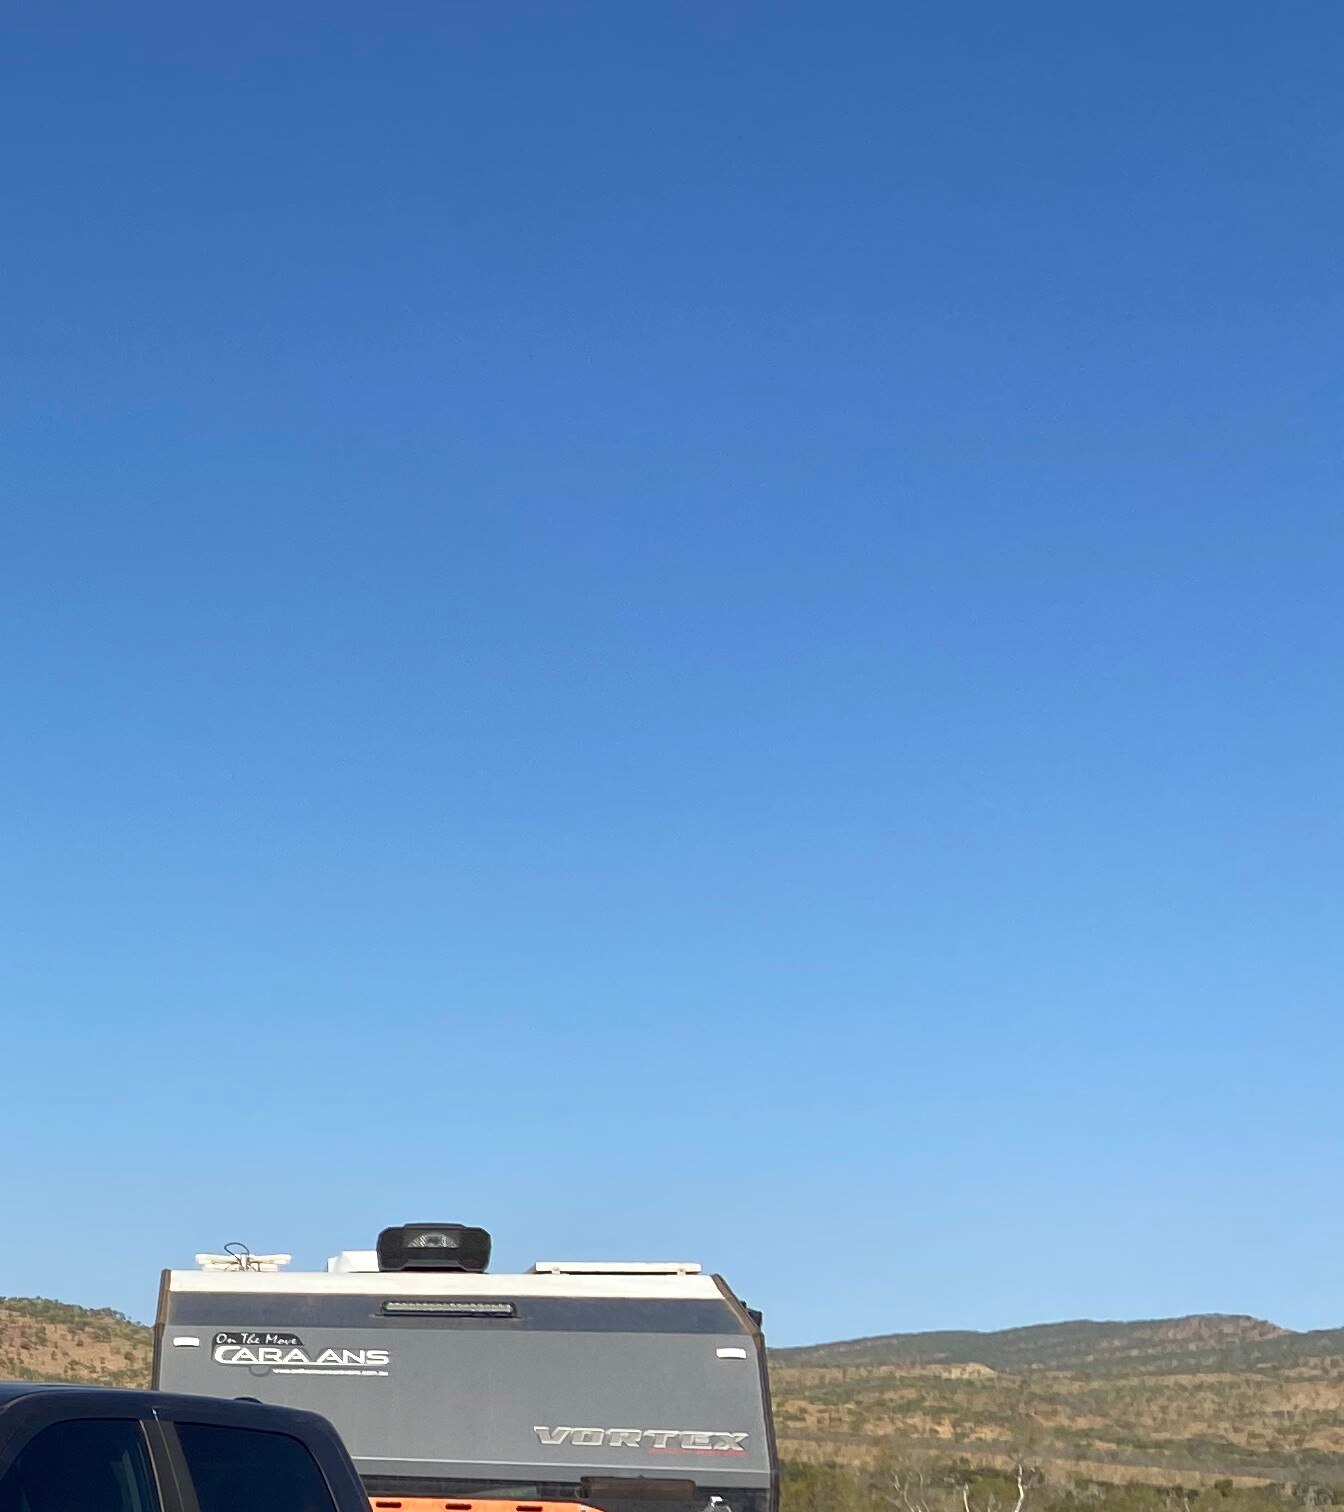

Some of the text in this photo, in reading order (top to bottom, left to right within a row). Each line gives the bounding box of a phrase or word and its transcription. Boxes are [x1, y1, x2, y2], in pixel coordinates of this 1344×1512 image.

[215, 1333, 298, 1345] On The Move
[214, 1345, 390, 1366] CARAANS
[533, 1425, 750, 1451] VORTEX
